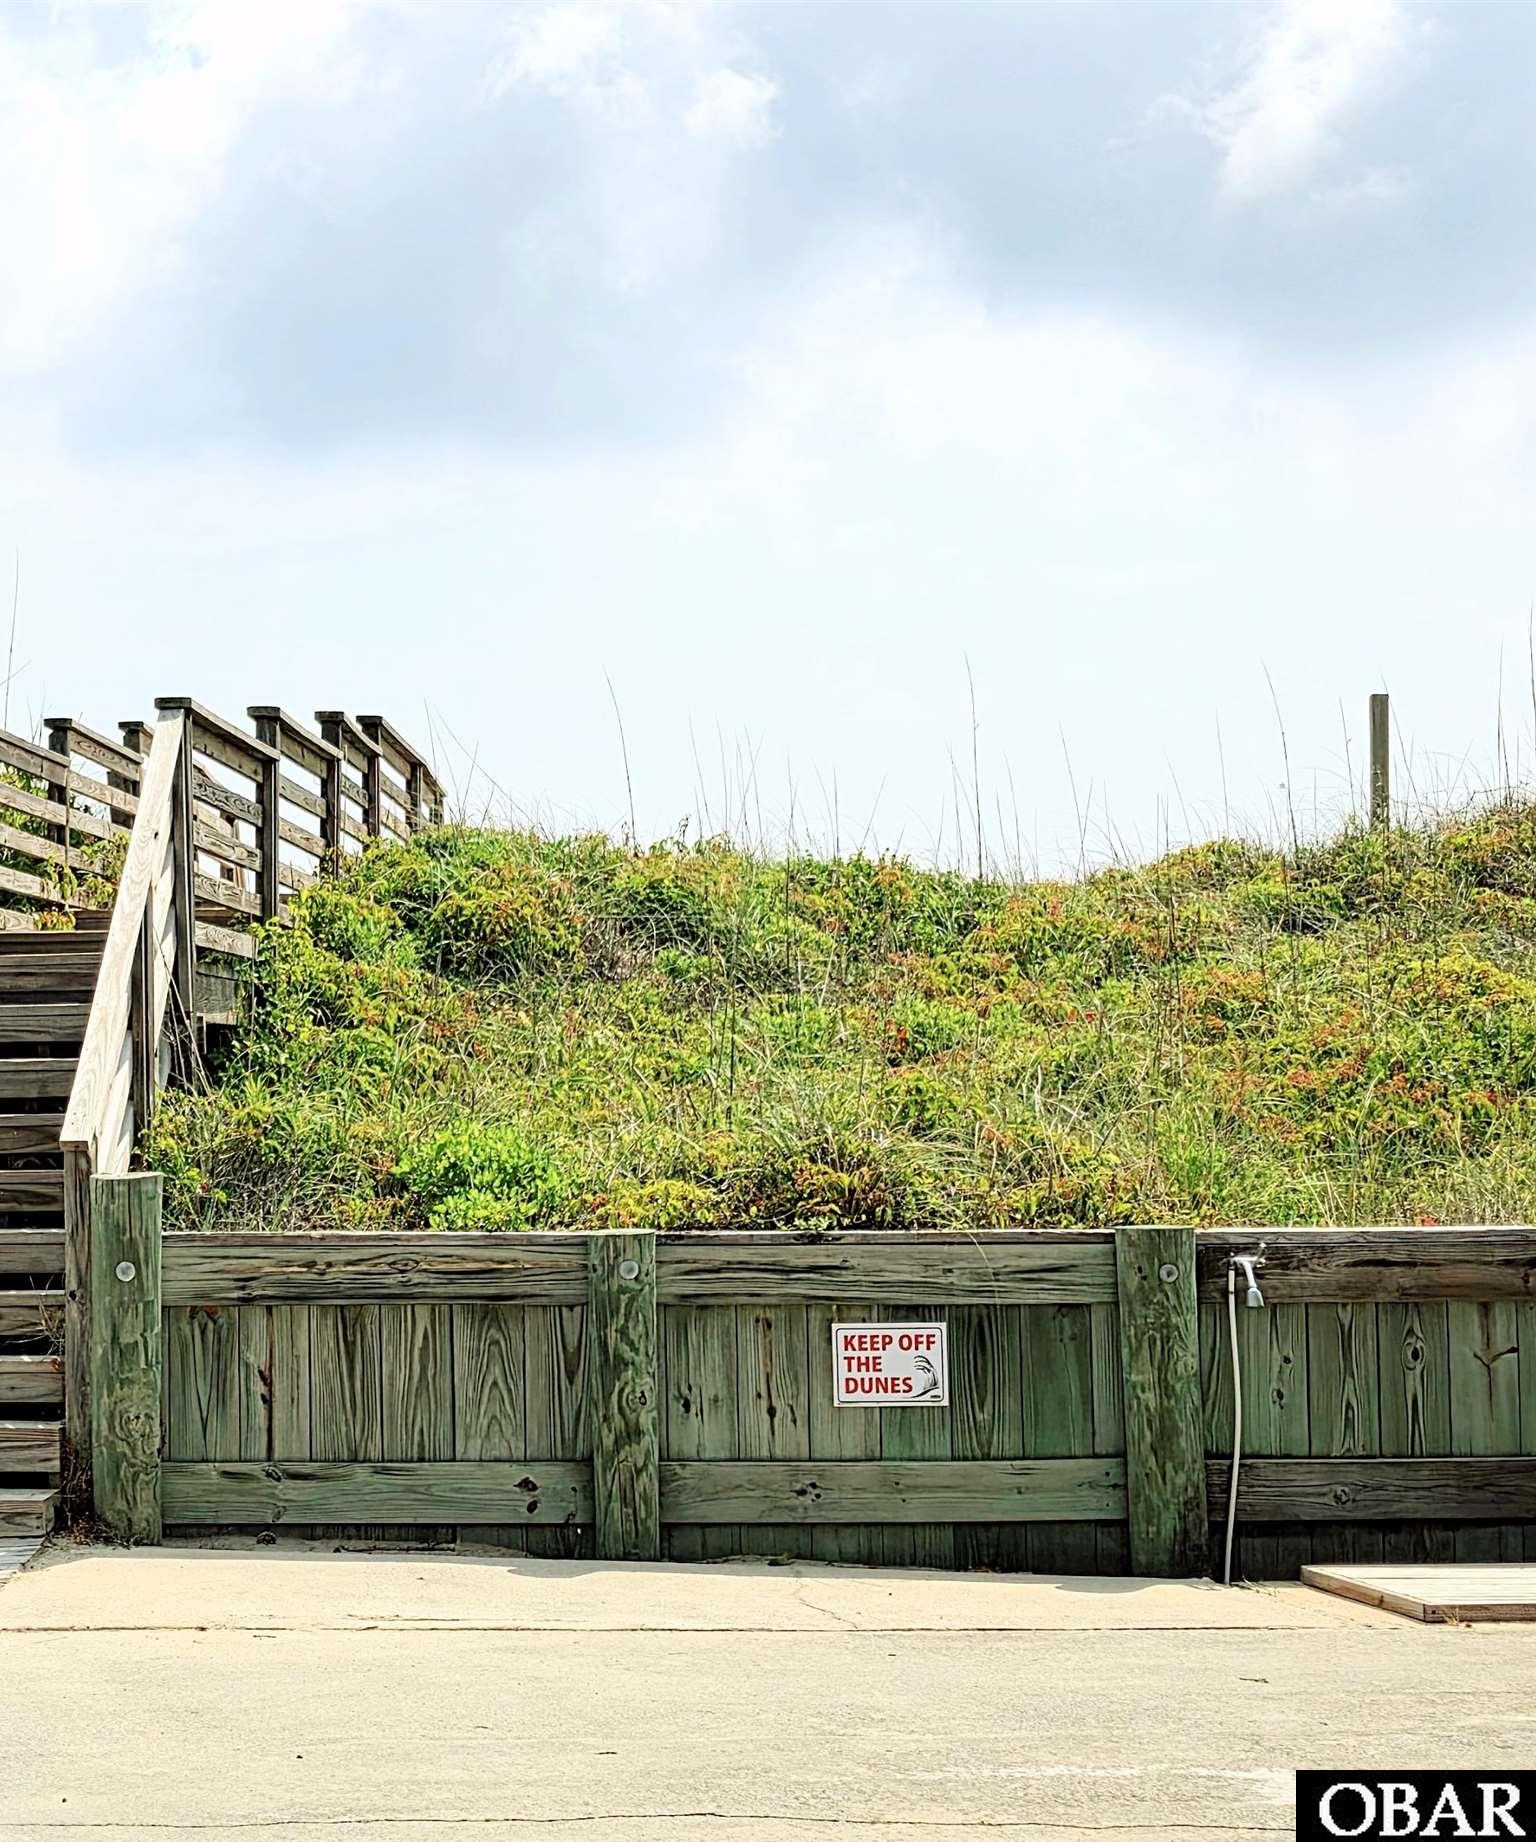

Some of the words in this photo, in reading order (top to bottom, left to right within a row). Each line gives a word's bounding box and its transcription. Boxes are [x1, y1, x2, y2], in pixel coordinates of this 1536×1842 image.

[843, 1334, 893, 1351] KEEP
[898, 1334, 936, 1351] OFF
[843, 1356, 883, 1373] THE
[844, 1377, 913, 1394] DUNES
